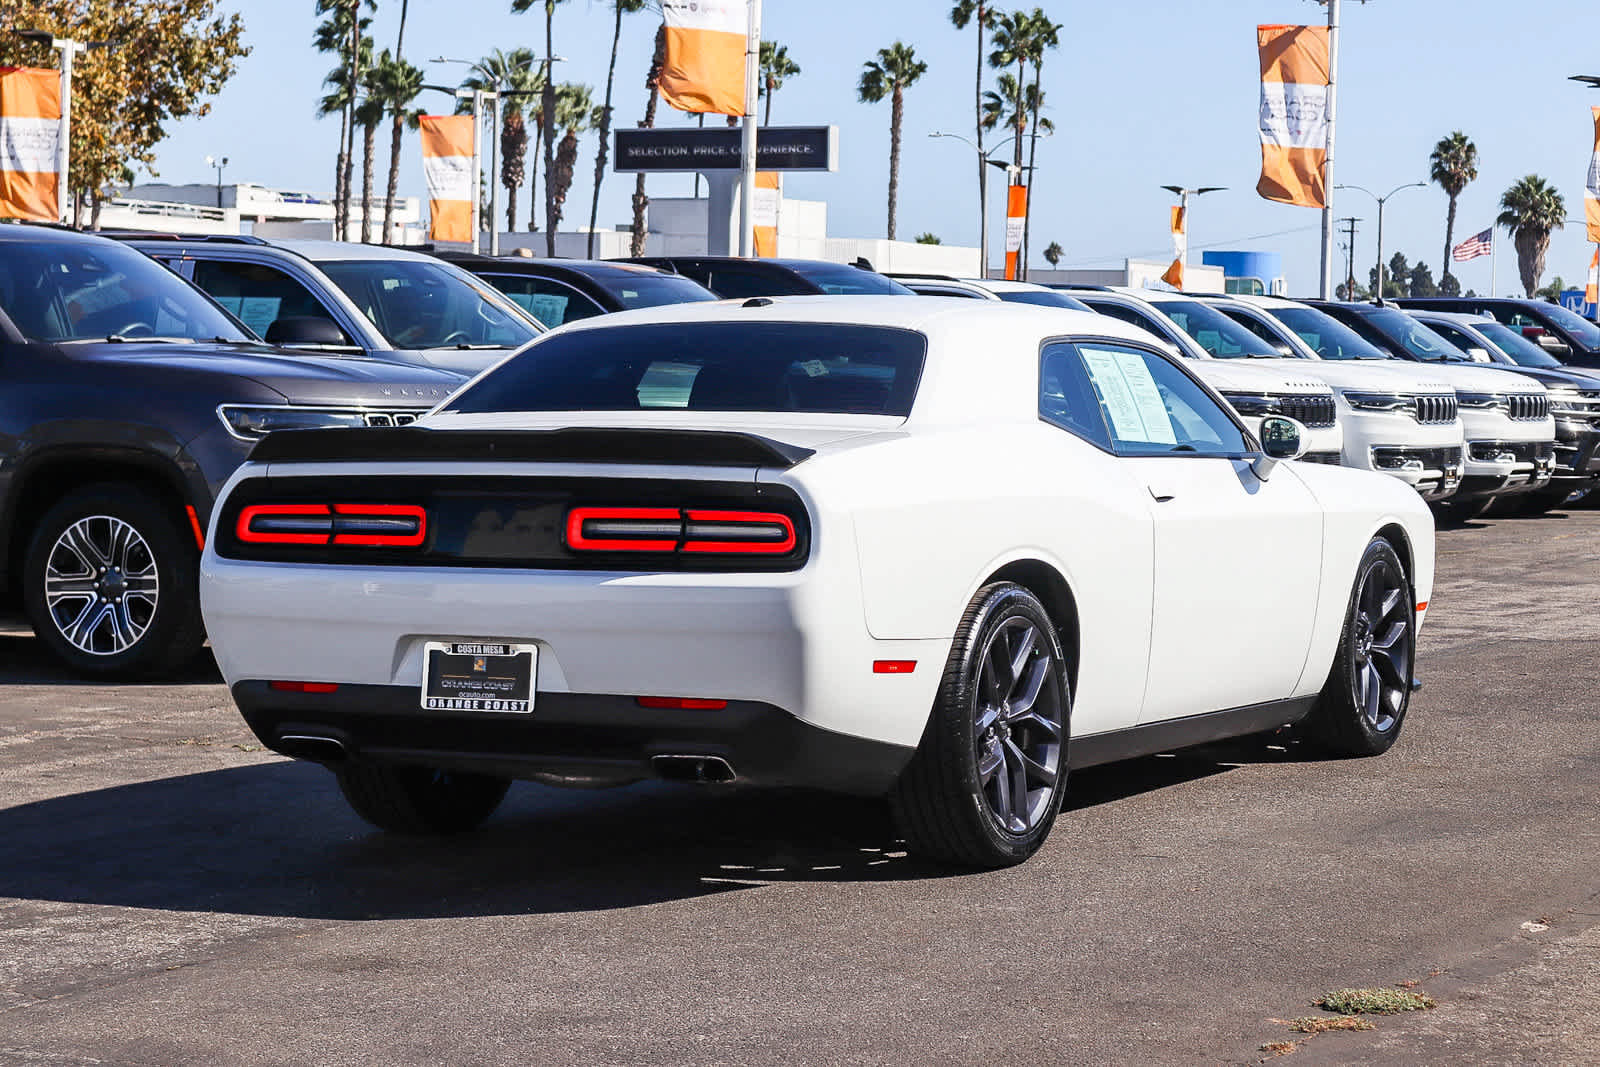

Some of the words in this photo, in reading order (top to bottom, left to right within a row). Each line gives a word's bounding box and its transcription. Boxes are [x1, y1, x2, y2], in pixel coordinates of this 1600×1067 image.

[628, 146, 690, 157] SELECTION.
[693, 145, 729, 156] PRICE.
[731, 144, 815, 155] CVENIENCE.
[457, 645, 481, 654] COSTA
[483, 645, 504, 655] MESA
[458, 691, 496, 699] ocauto.com
[429, 698, 479, 709] ORANGE
[484, 700, 526, 711] COAST
